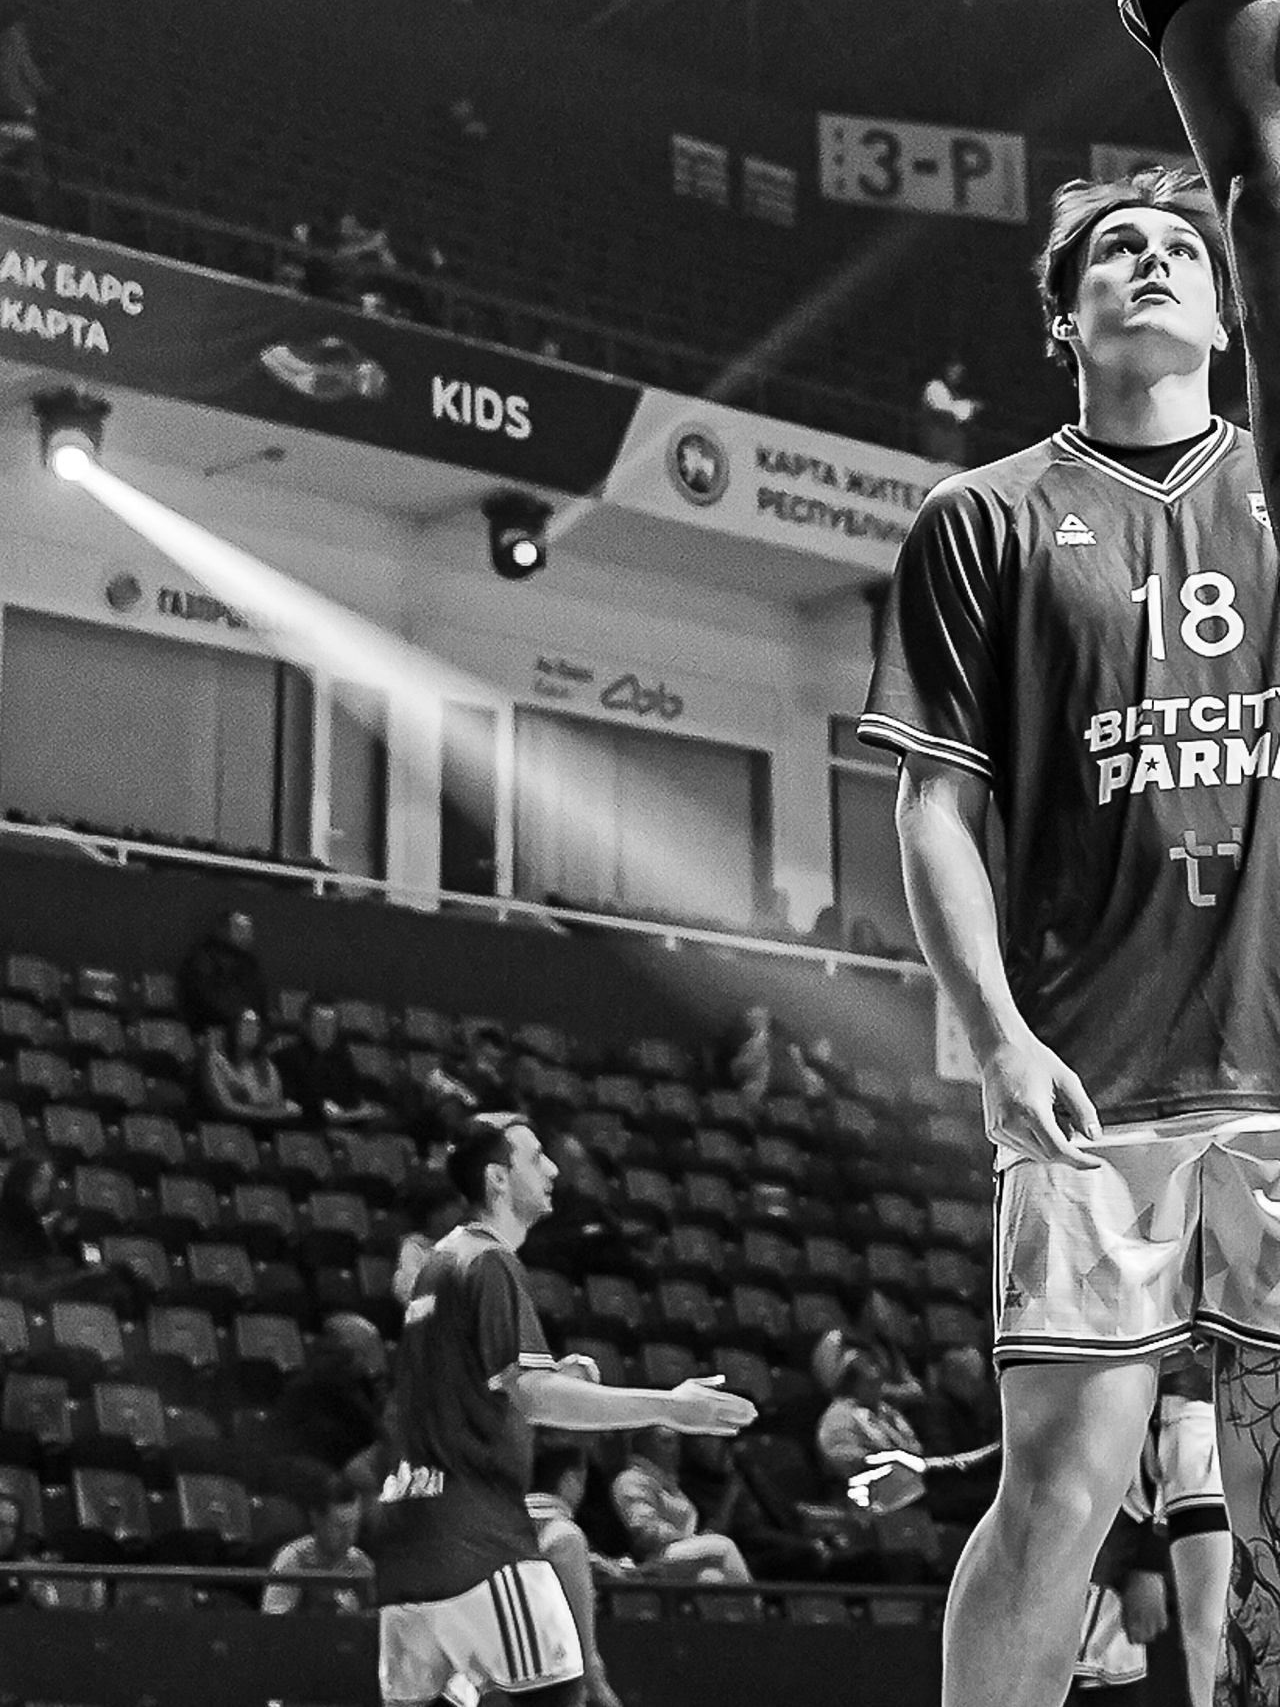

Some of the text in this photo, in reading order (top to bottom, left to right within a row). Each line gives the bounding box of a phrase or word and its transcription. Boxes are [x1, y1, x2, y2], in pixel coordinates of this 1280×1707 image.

[56, 262, 144, 315] БАРС
[0, 297, 110, 354] КАРТА
[431, 376, 532, 440] KIDS
[1131, 571, 1245, 661] 18
